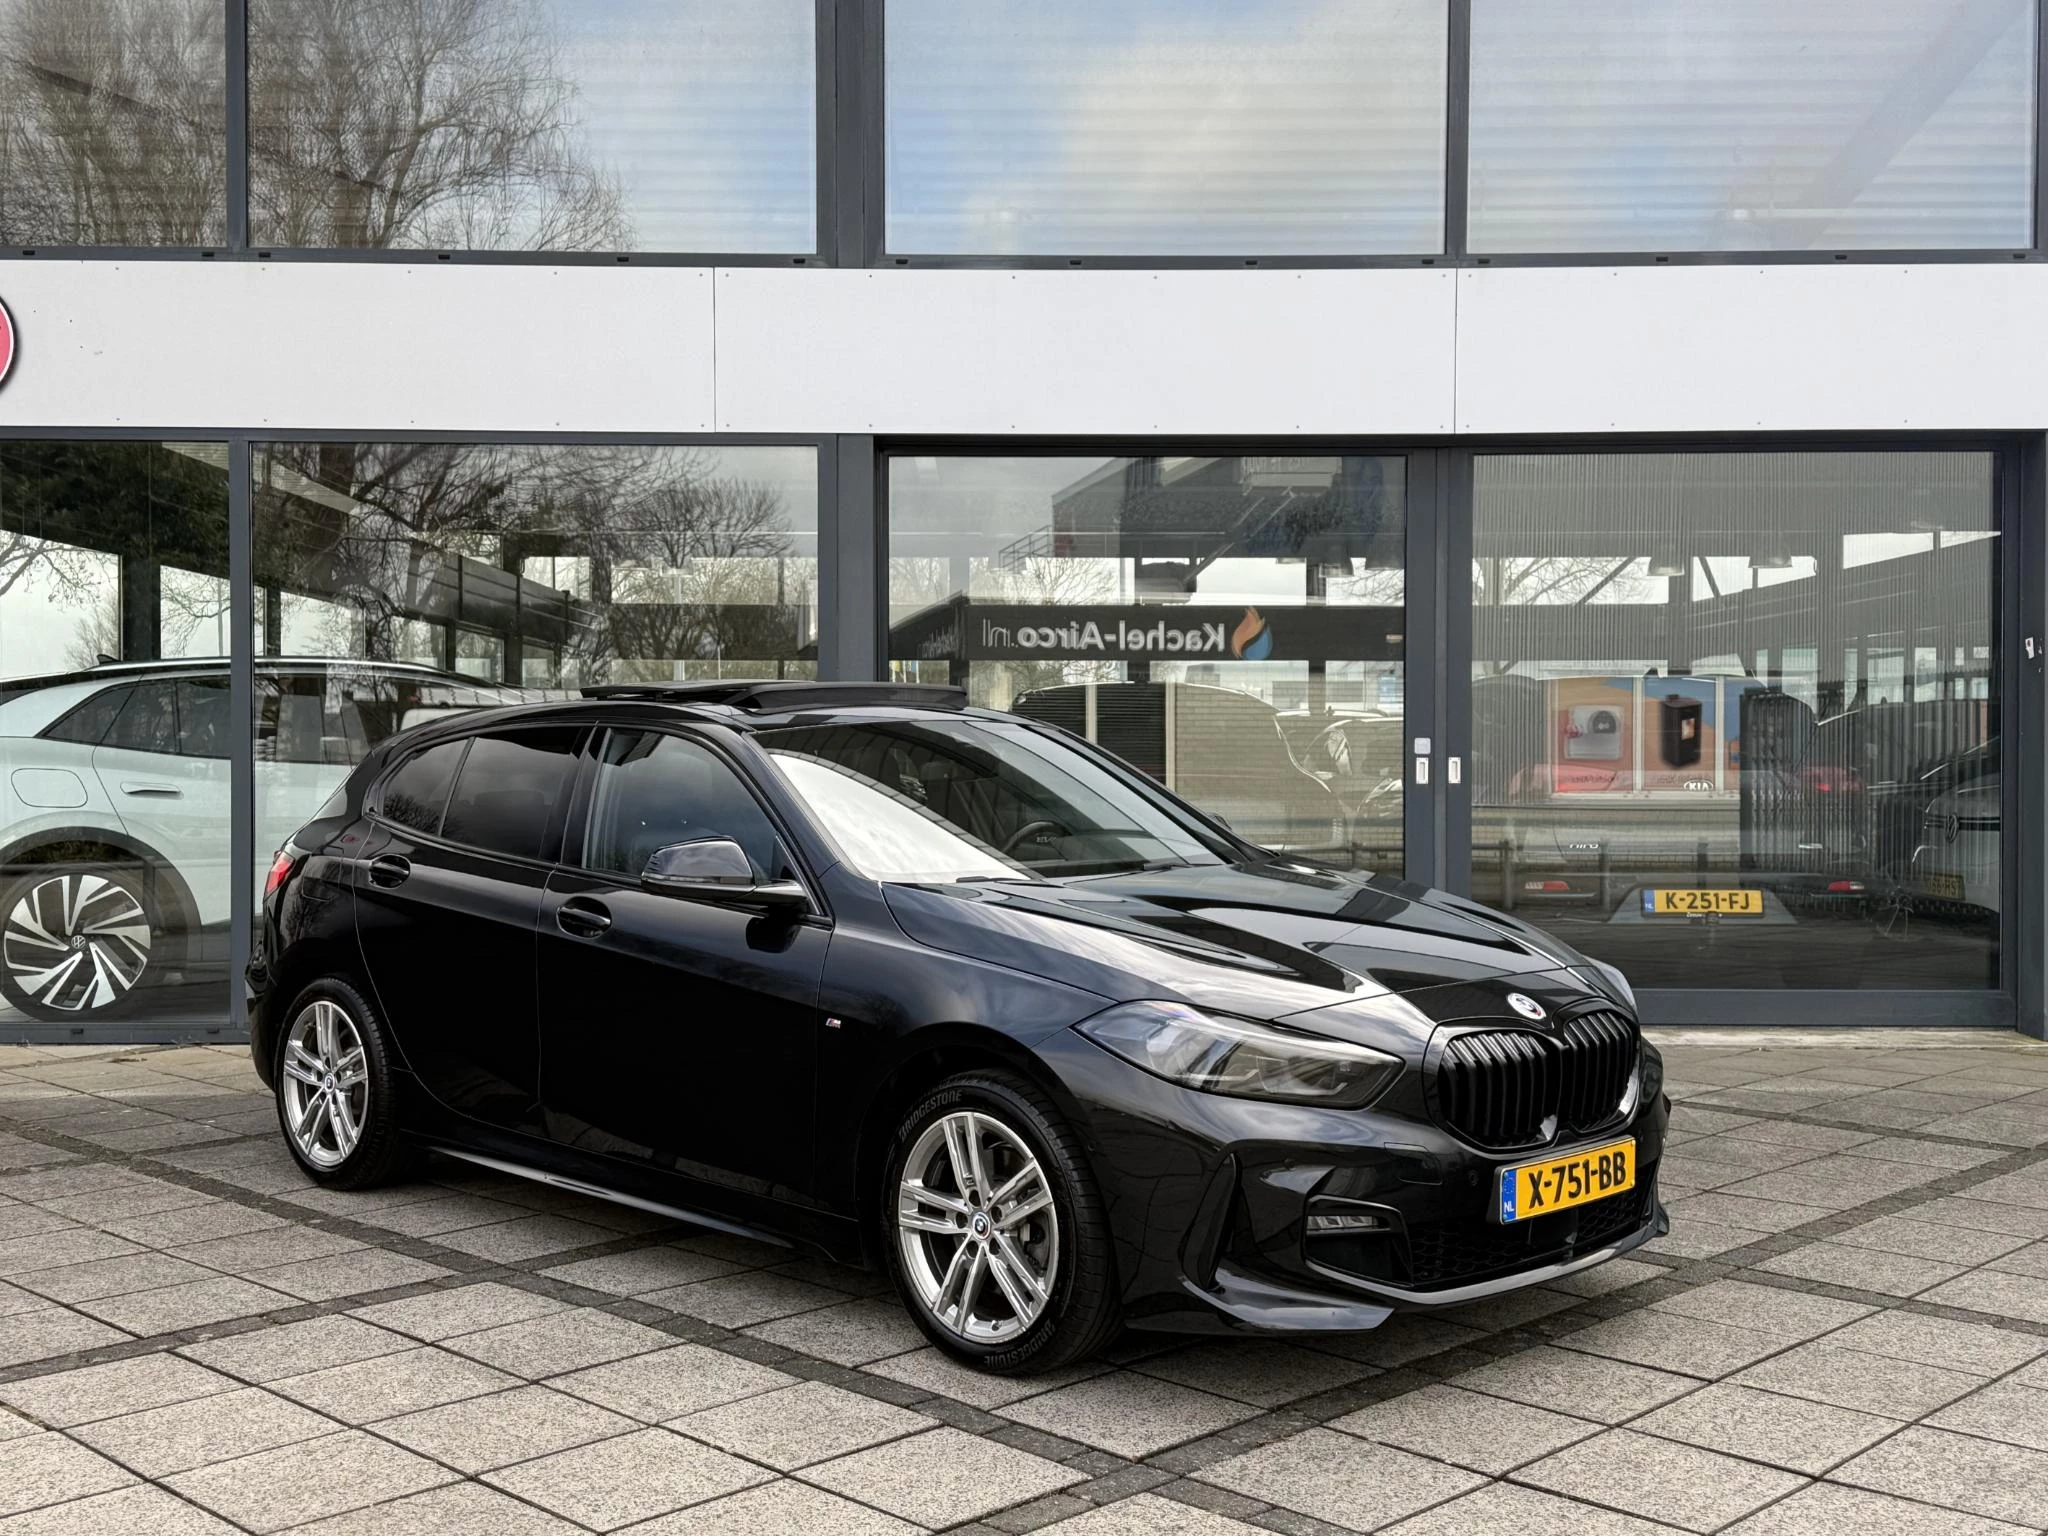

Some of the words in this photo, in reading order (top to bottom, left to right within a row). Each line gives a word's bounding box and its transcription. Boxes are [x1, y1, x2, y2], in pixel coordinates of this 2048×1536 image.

[1665, 891, 1750, 910] K-251-FJ
[1528, 1150, 1627, 1210] X-751-BB
[1503, 1201, 1515, 1213] NL
